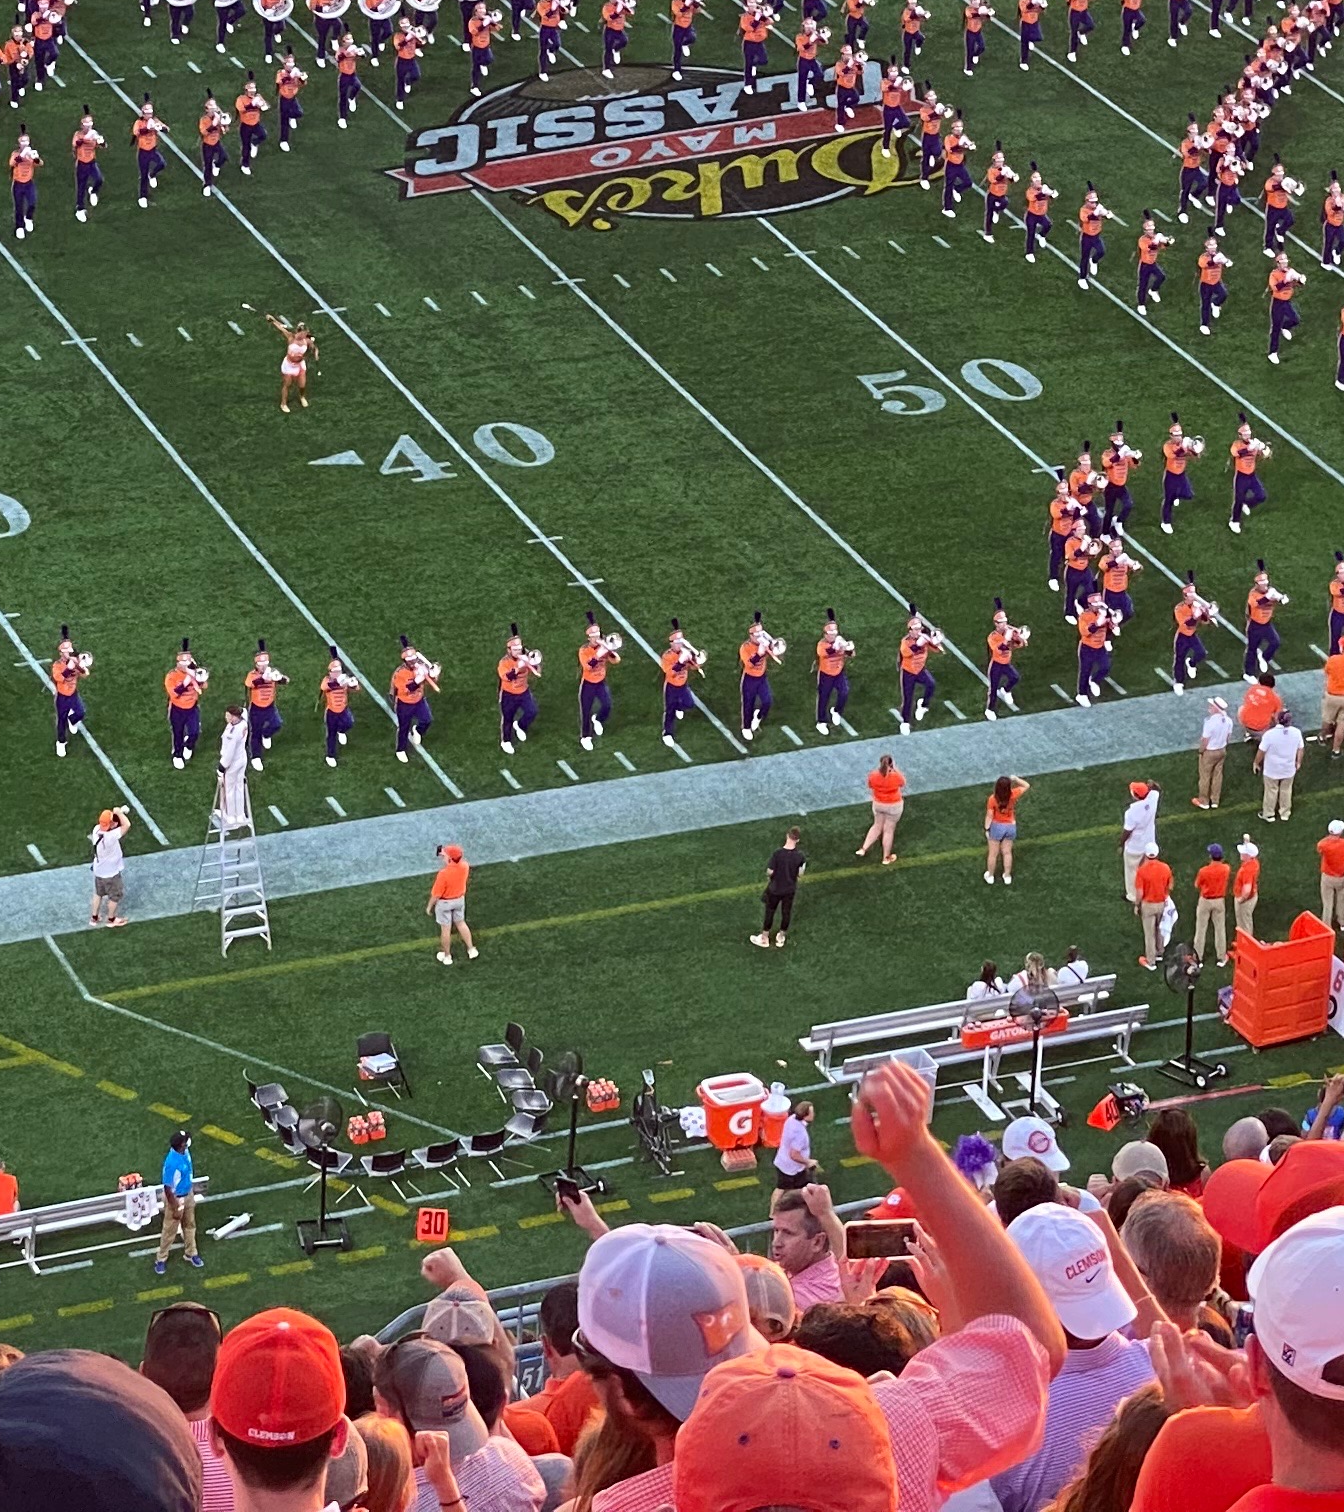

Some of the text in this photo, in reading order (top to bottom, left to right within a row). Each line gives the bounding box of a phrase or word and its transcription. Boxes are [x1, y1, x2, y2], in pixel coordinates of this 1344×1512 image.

[415, 60, 884, 176] CLASSIC
[590, 122, 777, 168] MAYO
[857, 357, 1044, 416] 50
[378, 421, 555, 483] 40
[729, 1108, 753, 1136] G
[420, 1210, 445, 1237] 30
[248, 1428, 295, 1441] CLEMSON
